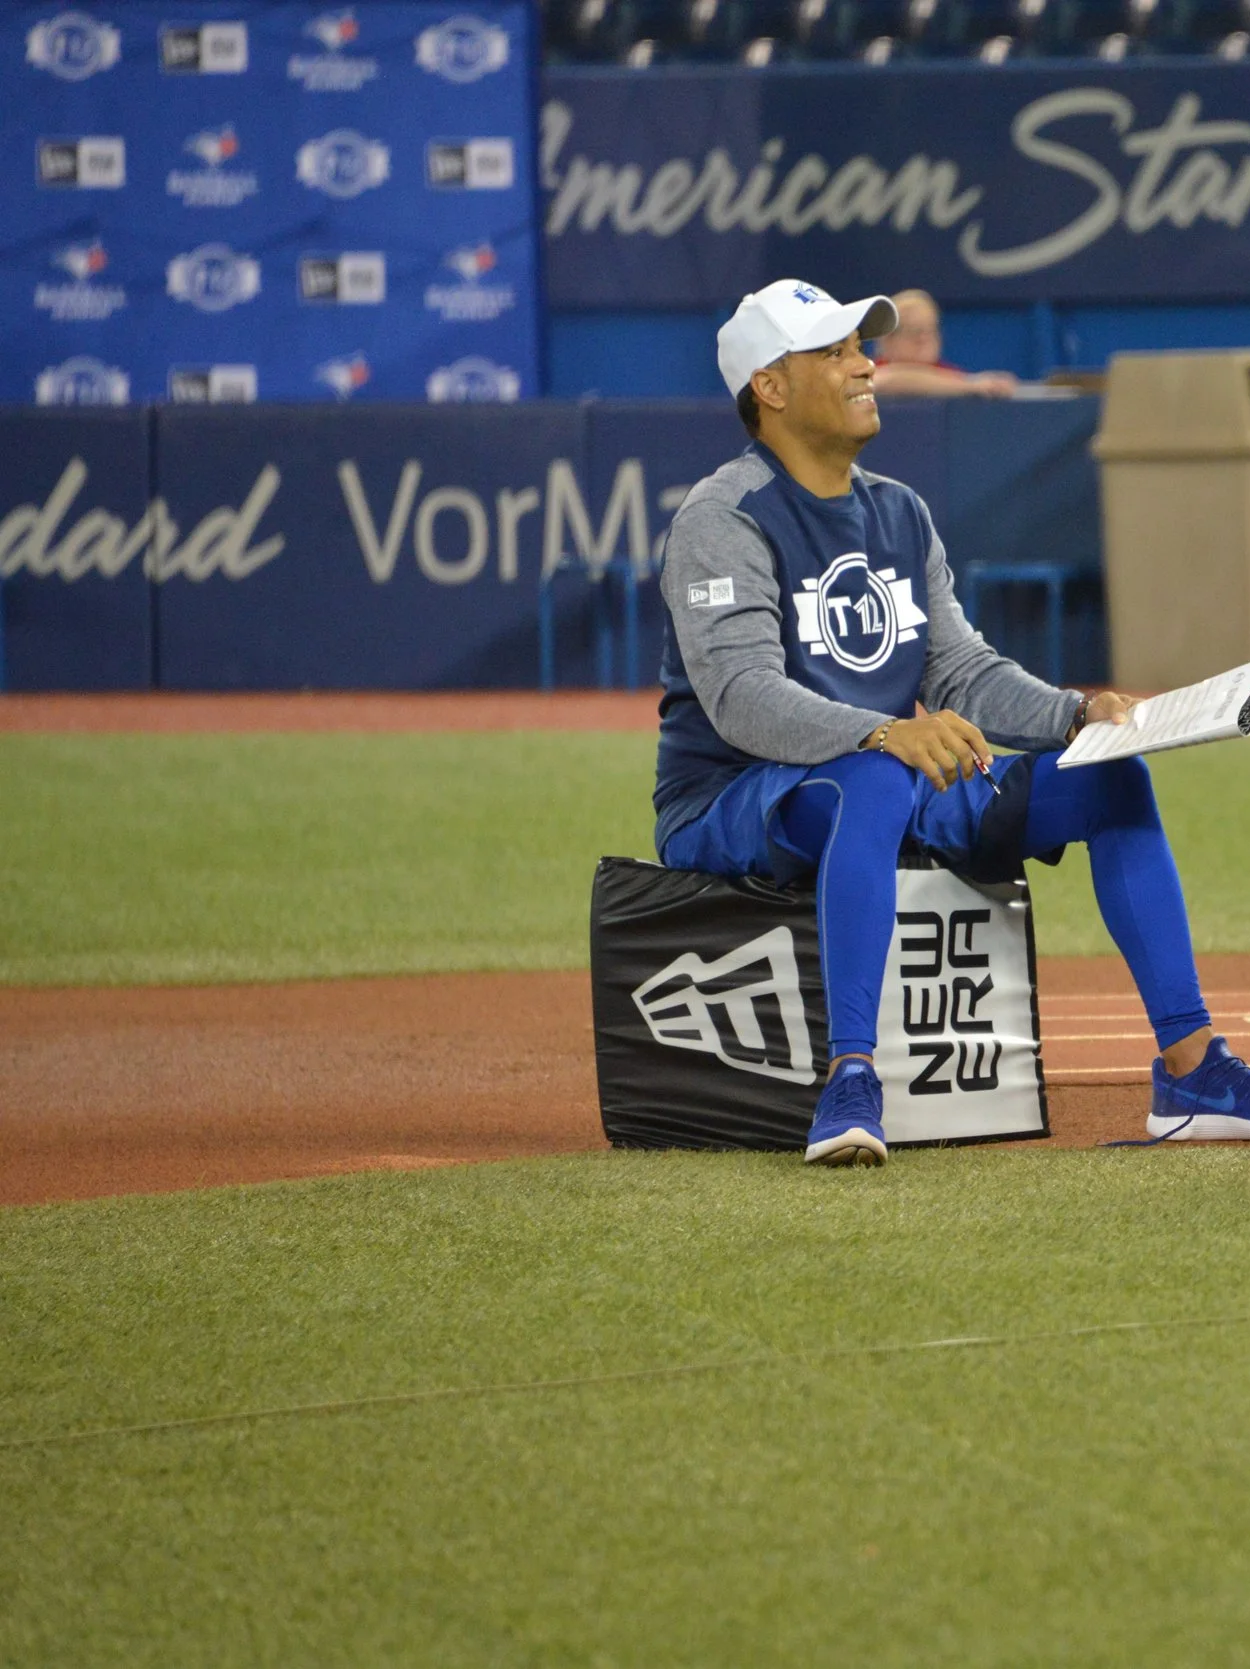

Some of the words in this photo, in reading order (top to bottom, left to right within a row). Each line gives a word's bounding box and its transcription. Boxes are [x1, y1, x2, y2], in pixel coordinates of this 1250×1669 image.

[337, 458, 693, 585] VorM
[896, 910, 955, 1096] NEW
[947, 908, 1003, 1092] ERA
